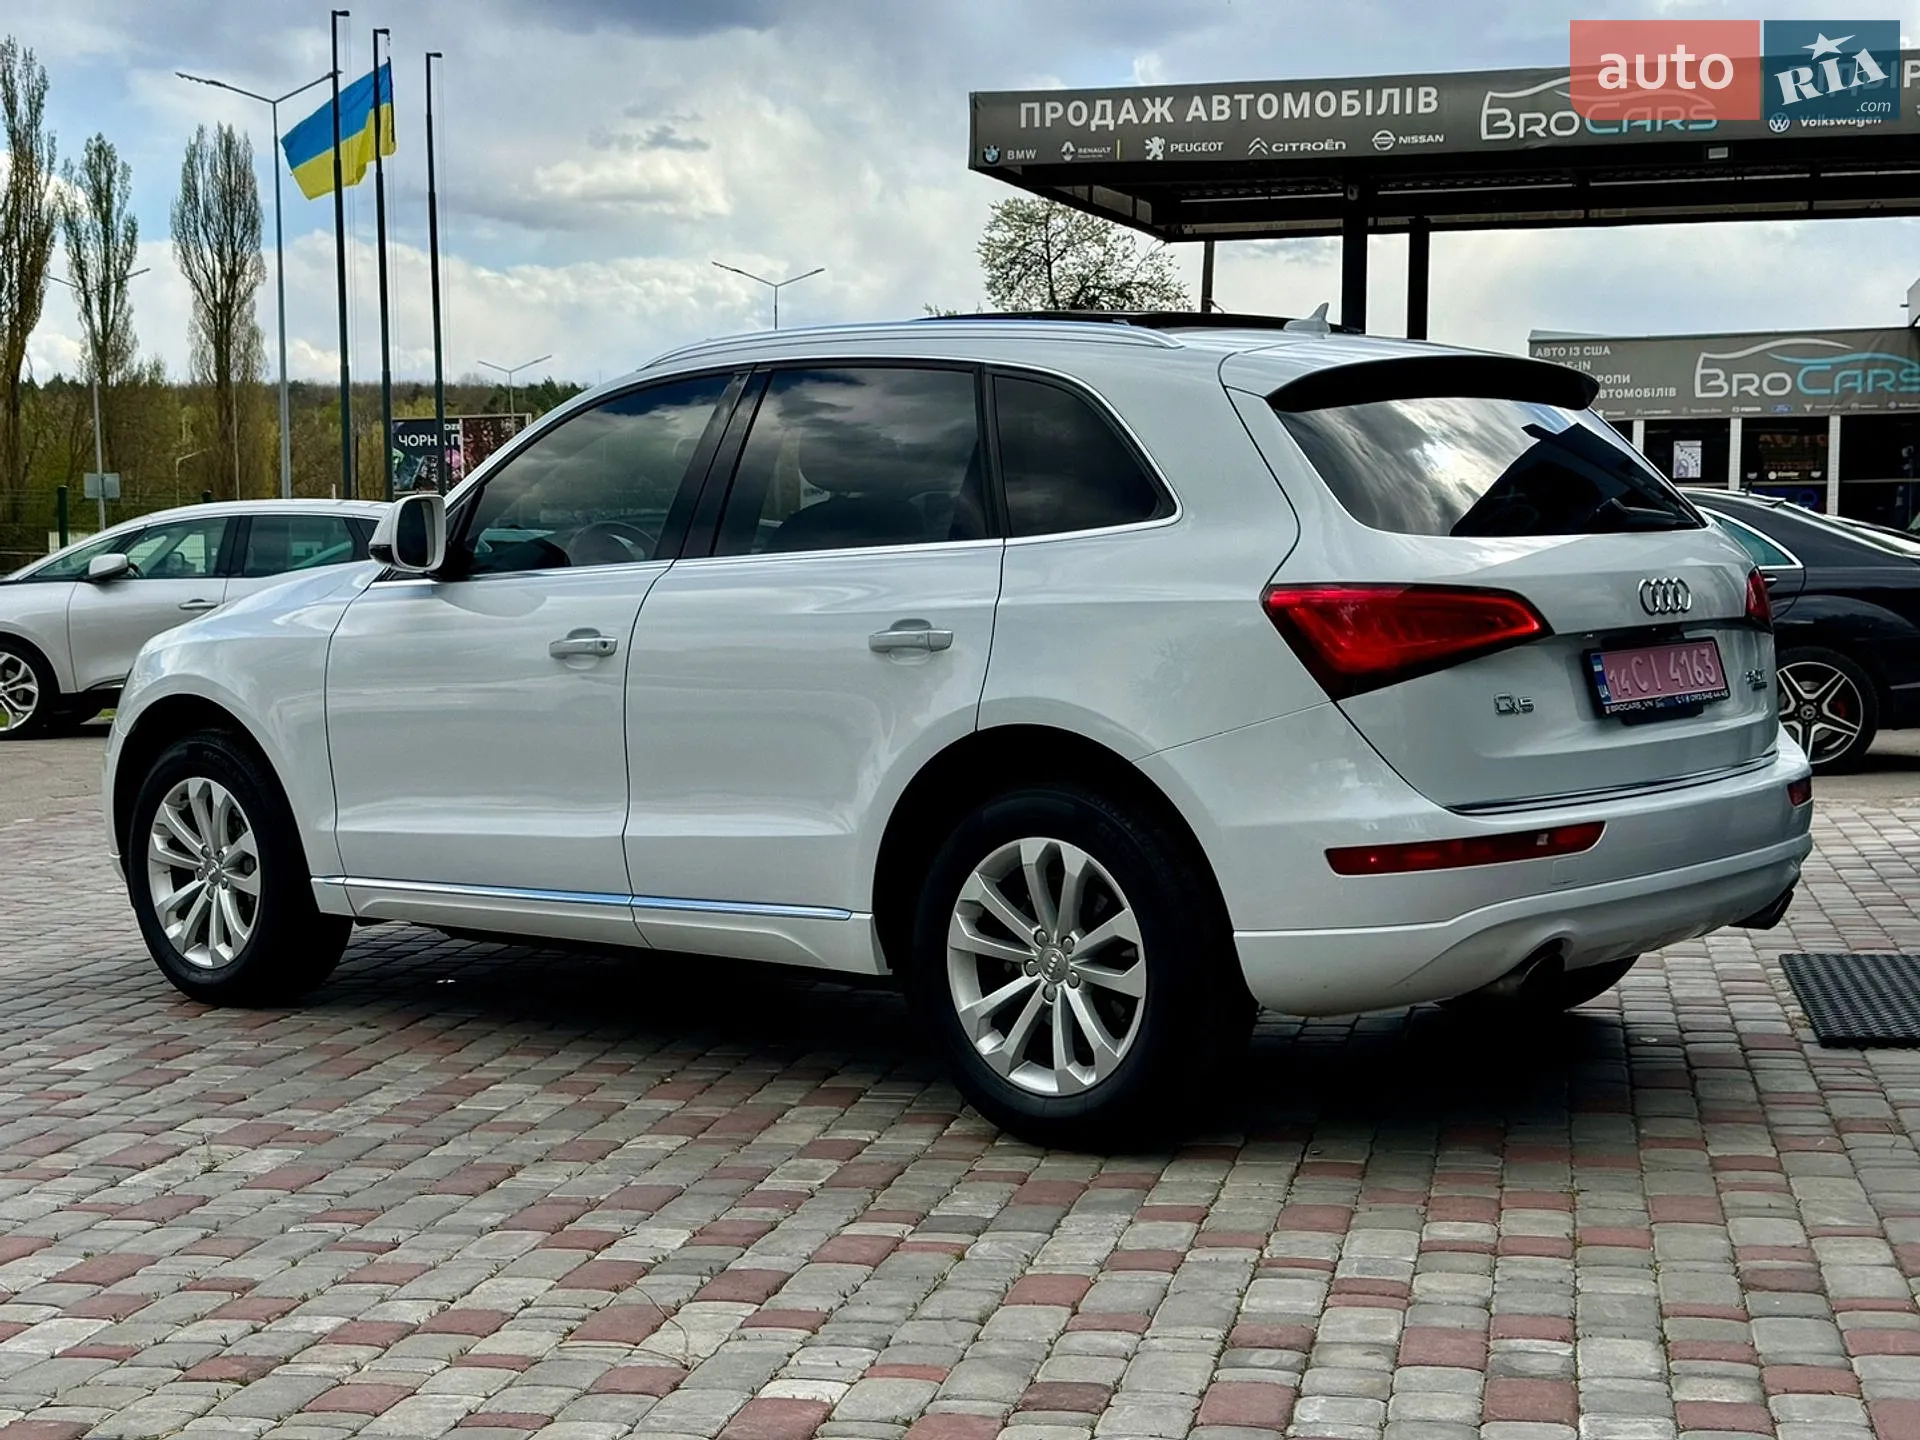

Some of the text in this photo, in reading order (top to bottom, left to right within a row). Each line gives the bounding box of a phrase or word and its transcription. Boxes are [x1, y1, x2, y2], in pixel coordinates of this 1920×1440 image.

[1019, 86, 1439, 132] ПРОДАЖ АВТОМОБІЛІВ
[1799, 114, 1883, 128] Volkswagen
[1398, 134, 1445, 145] NISSAN
[1170, 141, 1224, 153] PEUGEOT
[1006, 148, 1037, 160] BMW
[1535, 345, 1611, 357] АВТО ІЗ США
[1597, 374, 1631, 385] РОПИ
[399, 434, 449, 447] ЧОРН
[1669, 648, 1717, 688] 4163
[1494, 692, 1536, 715] Q5
